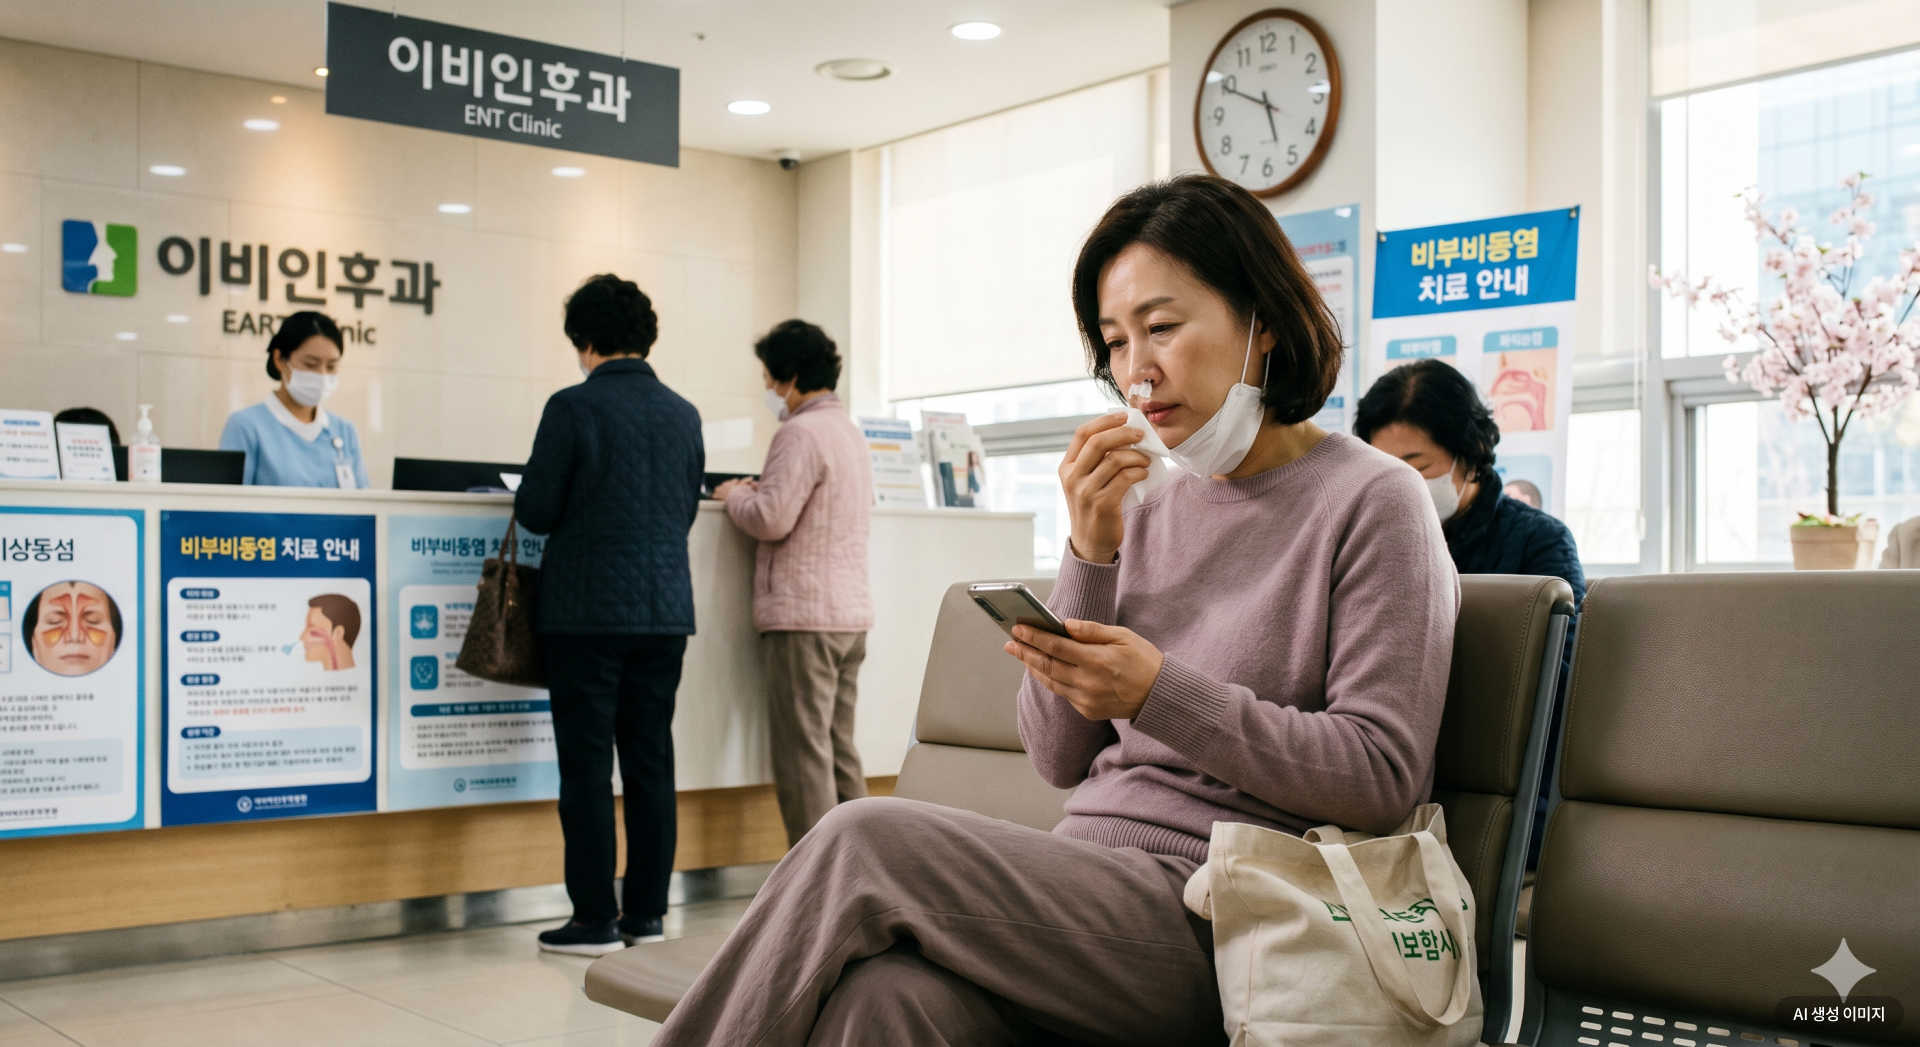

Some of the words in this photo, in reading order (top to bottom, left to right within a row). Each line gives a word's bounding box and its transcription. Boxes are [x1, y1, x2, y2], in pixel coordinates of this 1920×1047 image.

[1259, 31, 1277, 54] 12
[1288, 35, 1296, 55] 1
[1236, 47, 1251, 69] 11
[1305, 52, 1317, 74] 2
[388, 36, 631, 123] 이비인후과
[464, 104, 505, 129] ENT
[508, 111, 562, 139] Clinic
[1213, 107, 1224, 126] 9
[1305, 117, 1316, 137] 4
[1220, 135, 1232, 156] 8
[1286, 145, 1299, 166] 5
[1239, 154, 1250, 175] 7
[1262, 157, 1273, 178] 6
[1411, 226, 1539, 271] 비부비동염
[157, 236, 441, 315] 이비인후과
[1417, 272, 1470, 305] 치료
[1476, 263, 1529, 300] 안내
[181, 536, 276, 561] 비부비동염
[281, 537, 319, 561] 치료
[323, 538, 360, 562] 안내
[411, 537, 486, 557] 비부비동염
